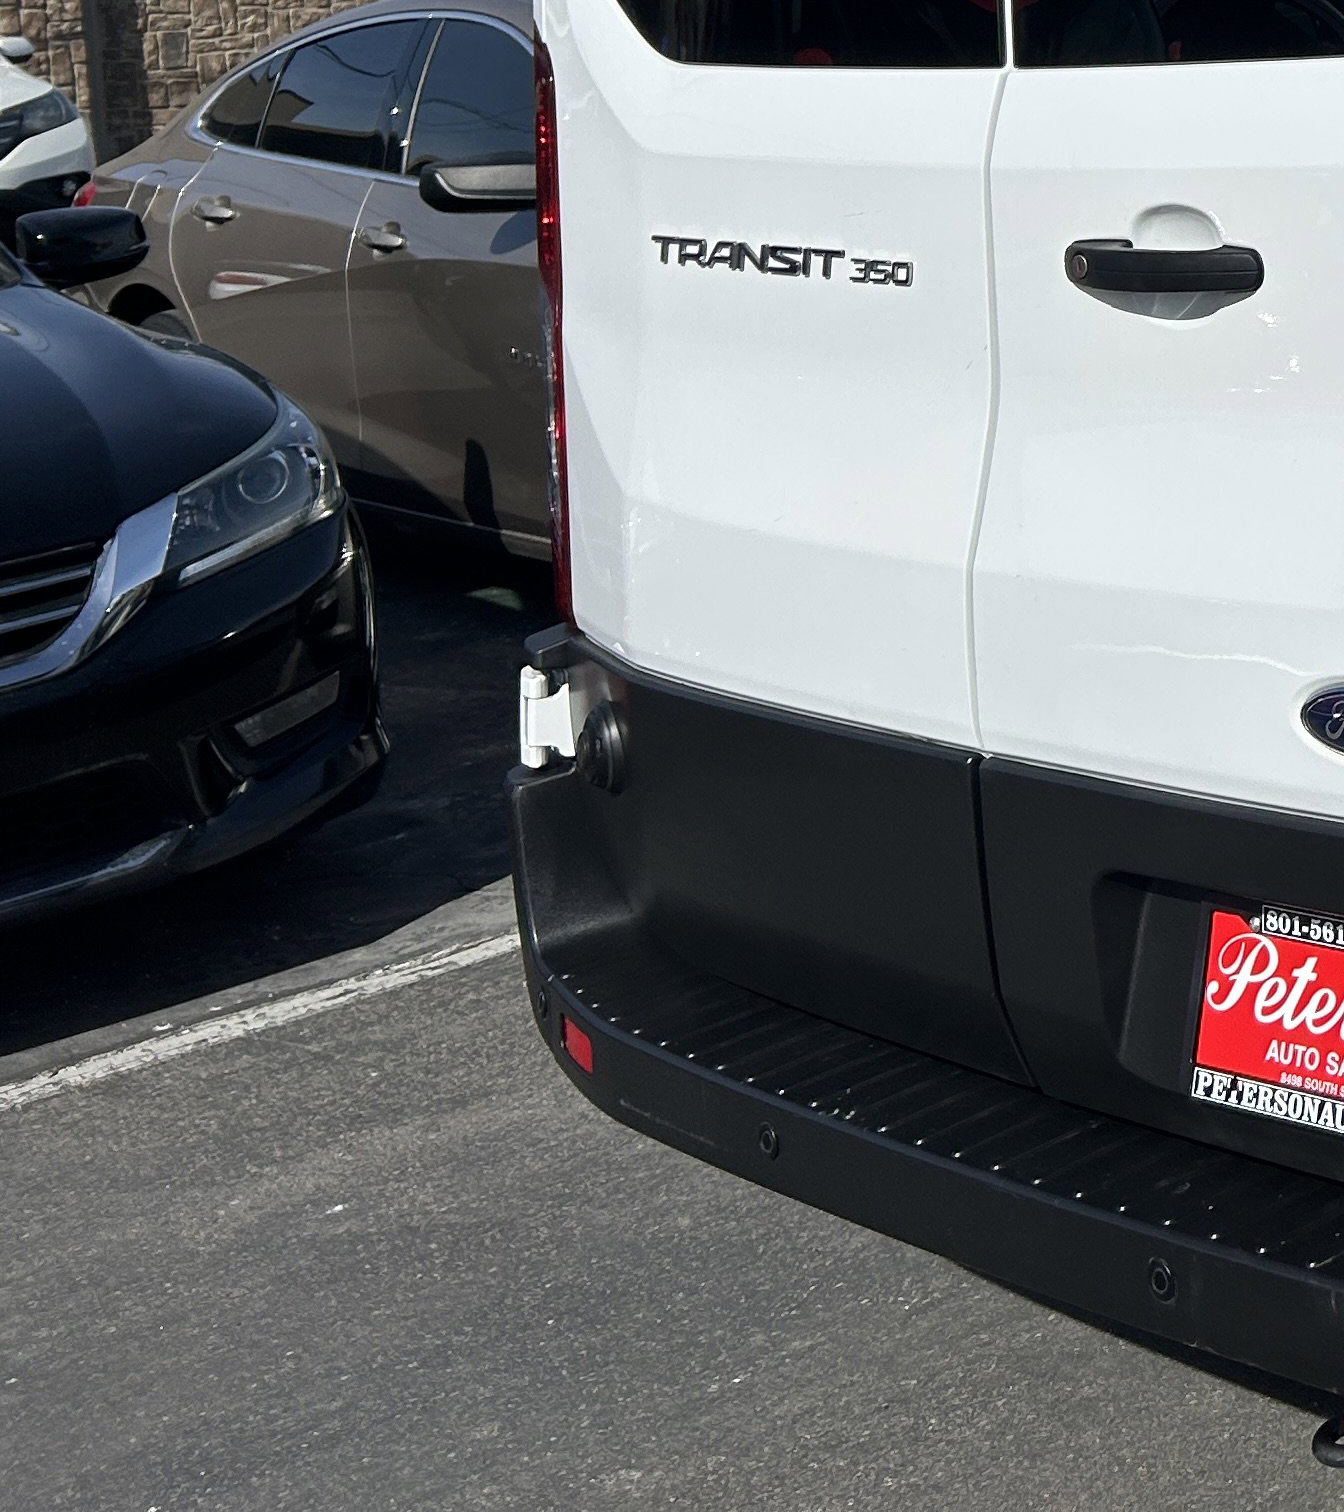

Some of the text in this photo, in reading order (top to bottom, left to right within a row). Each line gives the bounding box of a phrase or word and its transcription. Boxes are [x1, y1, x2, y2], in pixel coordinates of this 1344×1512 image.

[651, 234, 914, 288] TRANSIT 350
[1265, 1038, 1321, 1071] AUTO
[1303, 1077, 1338, 1096] SOUTH
